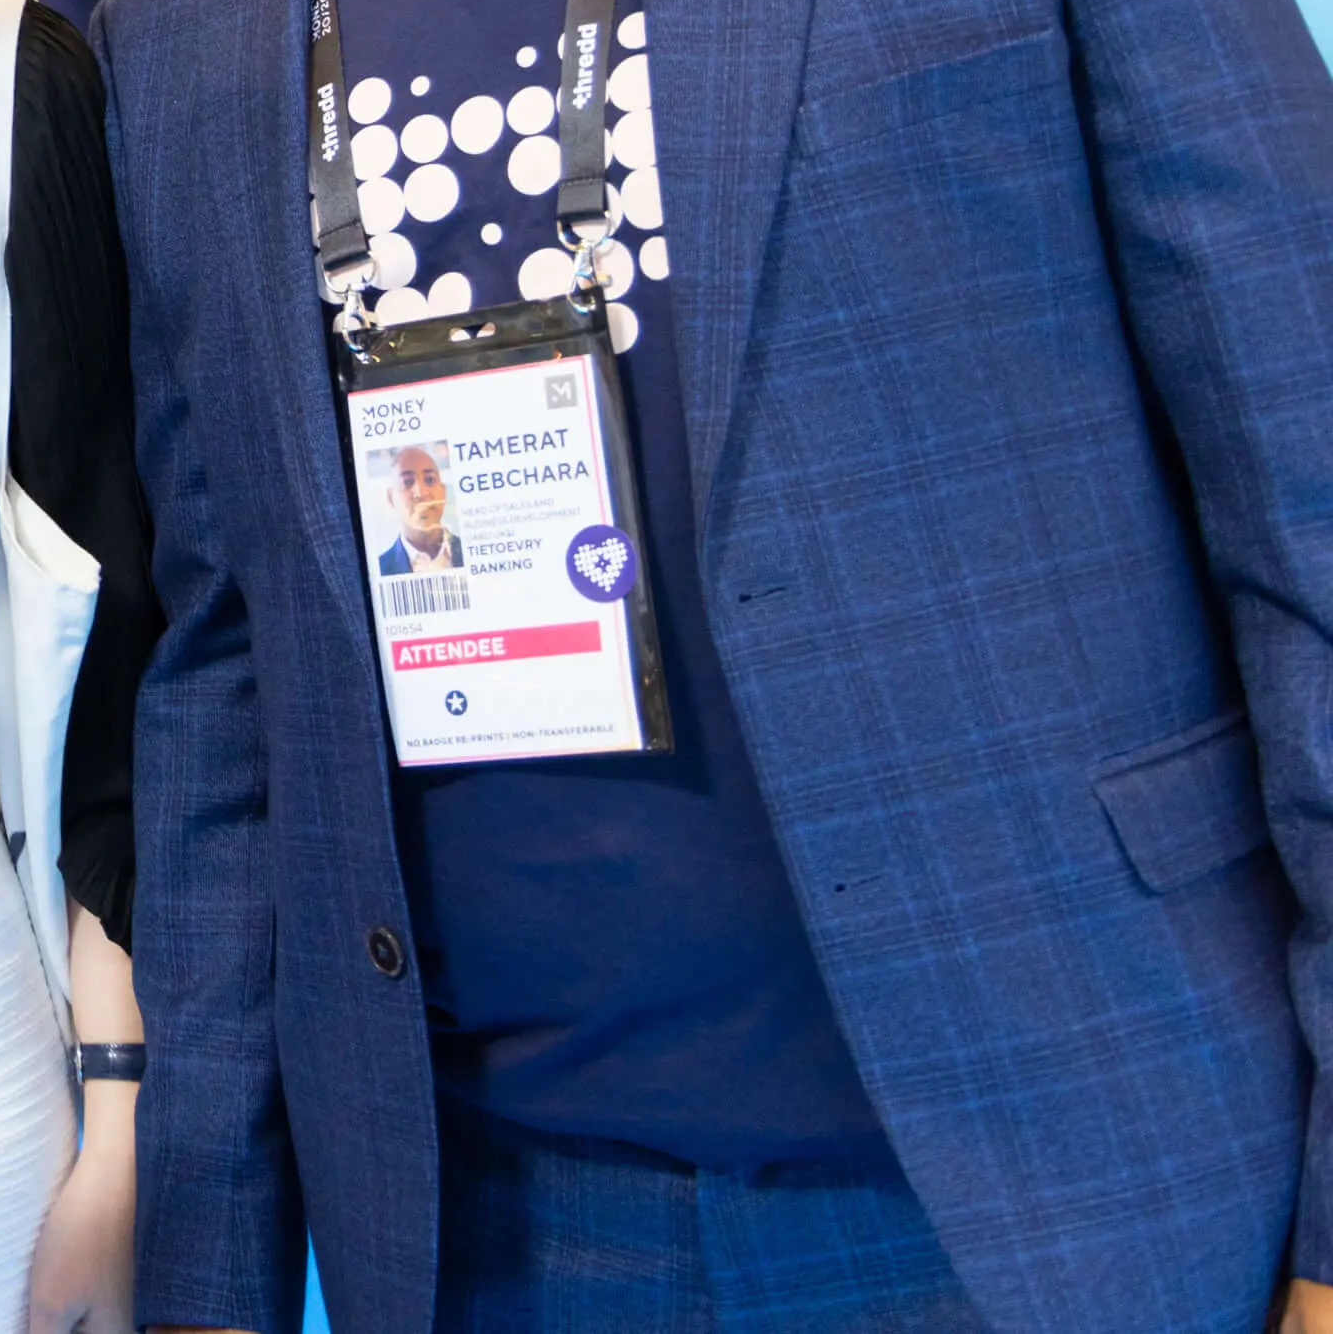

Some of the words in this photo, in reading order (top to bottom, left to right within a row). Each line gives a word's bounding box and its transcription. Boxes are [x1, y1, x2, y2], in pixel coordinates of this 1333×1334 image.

[572, 22, 598, 110] thredd
[317, 82, 340, 162] thredd
[362, 398, 425, 421] MONEY
[363, 416, 421, 437] 20/20
[454, 429, 569, 462] TAMERAT
[459, 461, 589, 494] GEBCHARA
[467, 539, 542, 557] TIETOEVRY
[470, 558, 533, 575] BANKING
[399, 636, 506, 665] ATTENDEE
